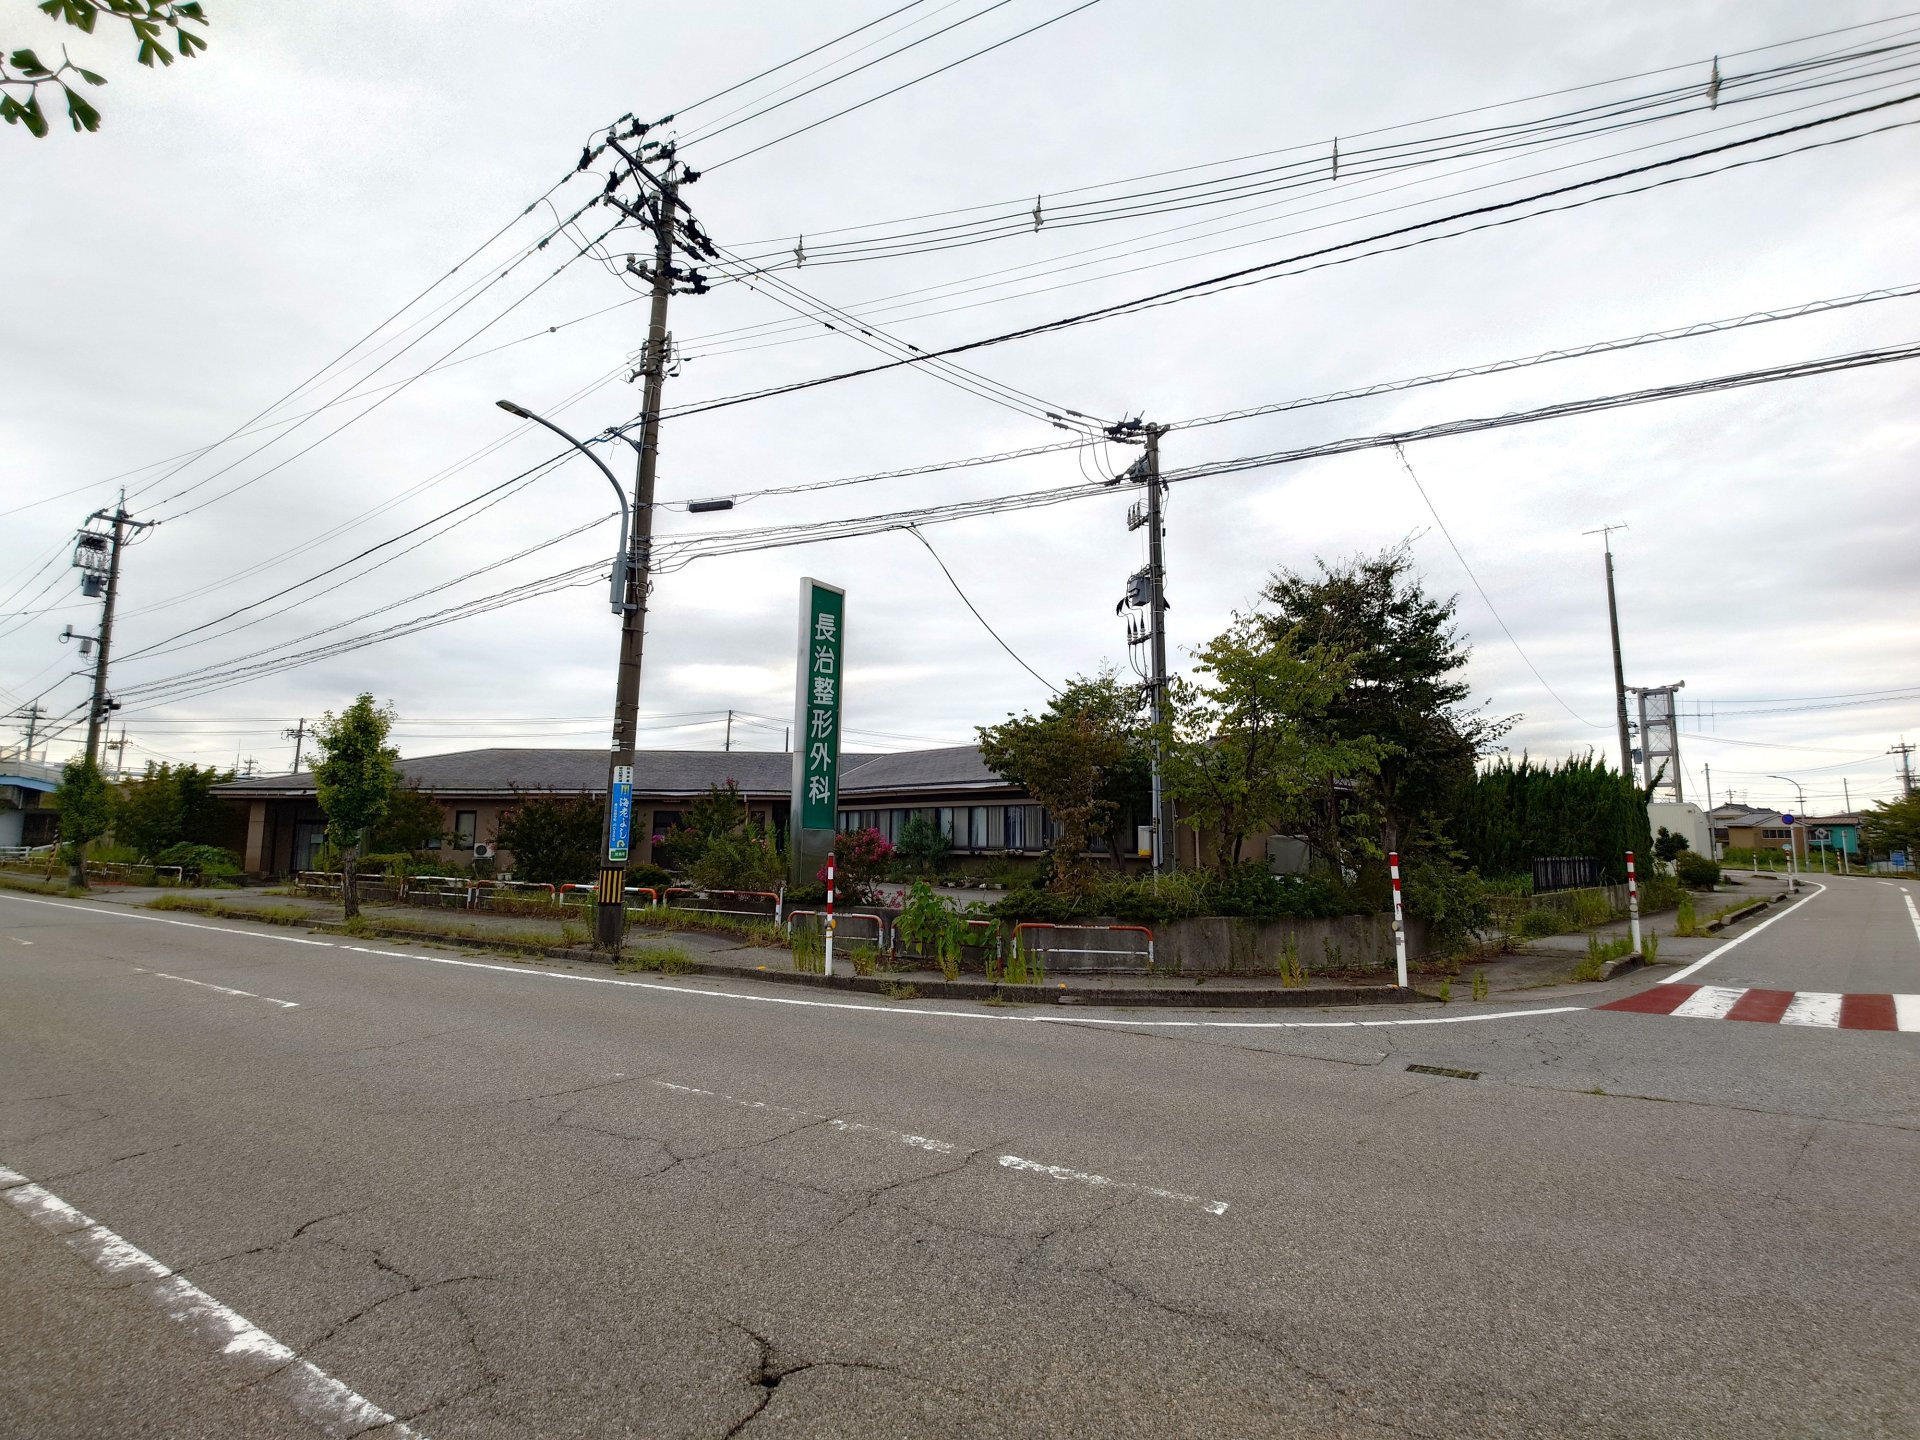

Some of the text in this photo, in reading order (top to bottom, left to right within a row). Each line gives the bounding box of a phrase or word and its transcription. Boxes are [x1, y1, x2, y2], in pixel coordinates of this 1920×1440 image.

[808, 612, 836, 806] 長治整形外科
